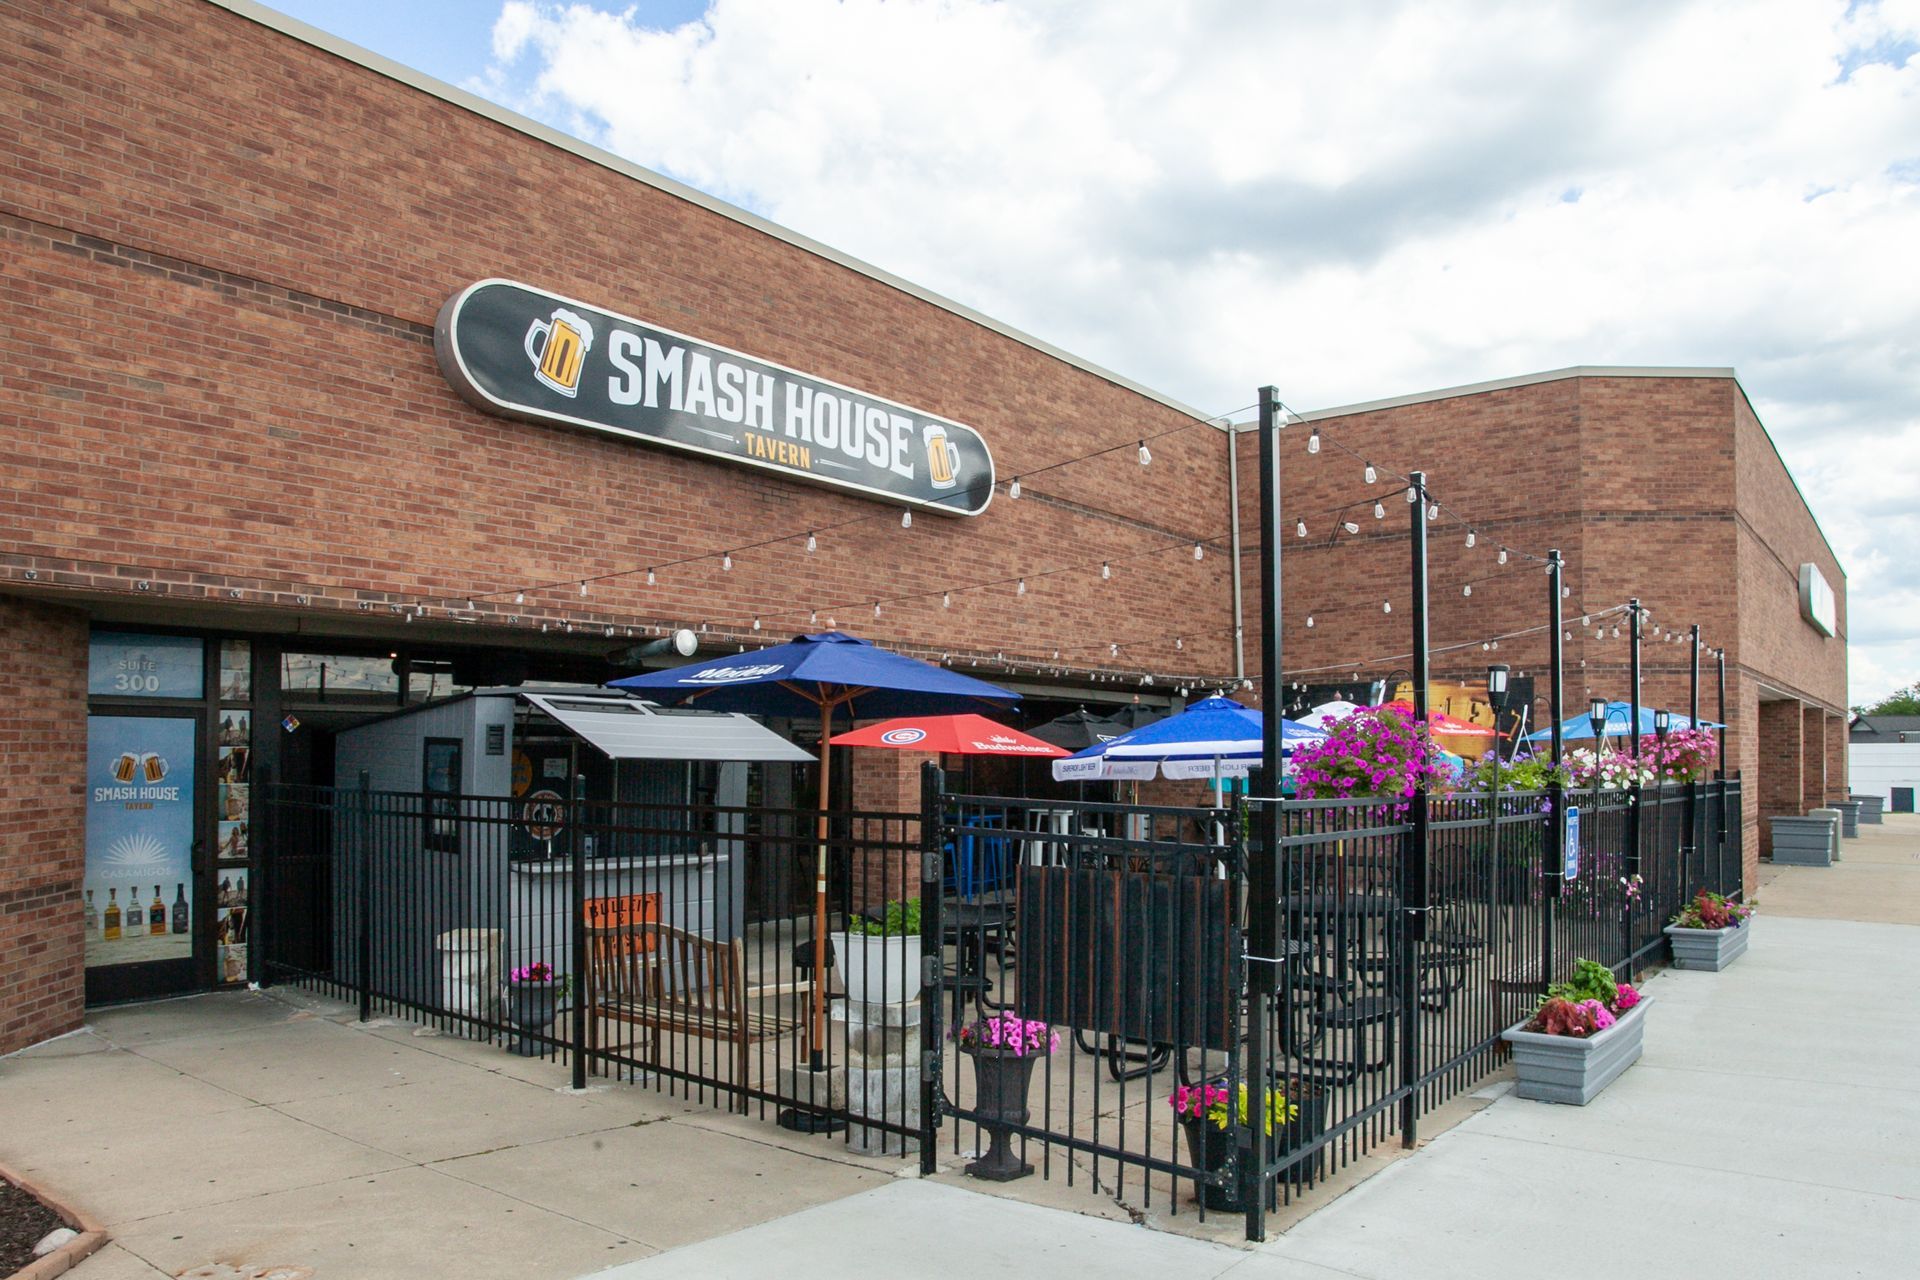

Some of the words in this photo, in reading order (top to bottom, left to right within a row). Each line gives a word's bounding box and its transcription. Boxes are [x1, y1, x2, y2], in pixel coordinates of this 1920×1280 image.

[608, 329, 775, 431] SMASH
[785, 381, 915, 480] HOUSE
[745, 432, 811, 469] TAVERN
[120, 661, 156, 672] SUITE
[115, 674, 159, 692] 300
[94, 787, 137, 801] SMASH
[140, 787, 179, 800] HOUSE
[101, 867, 172, 879] CASAMIGOS
